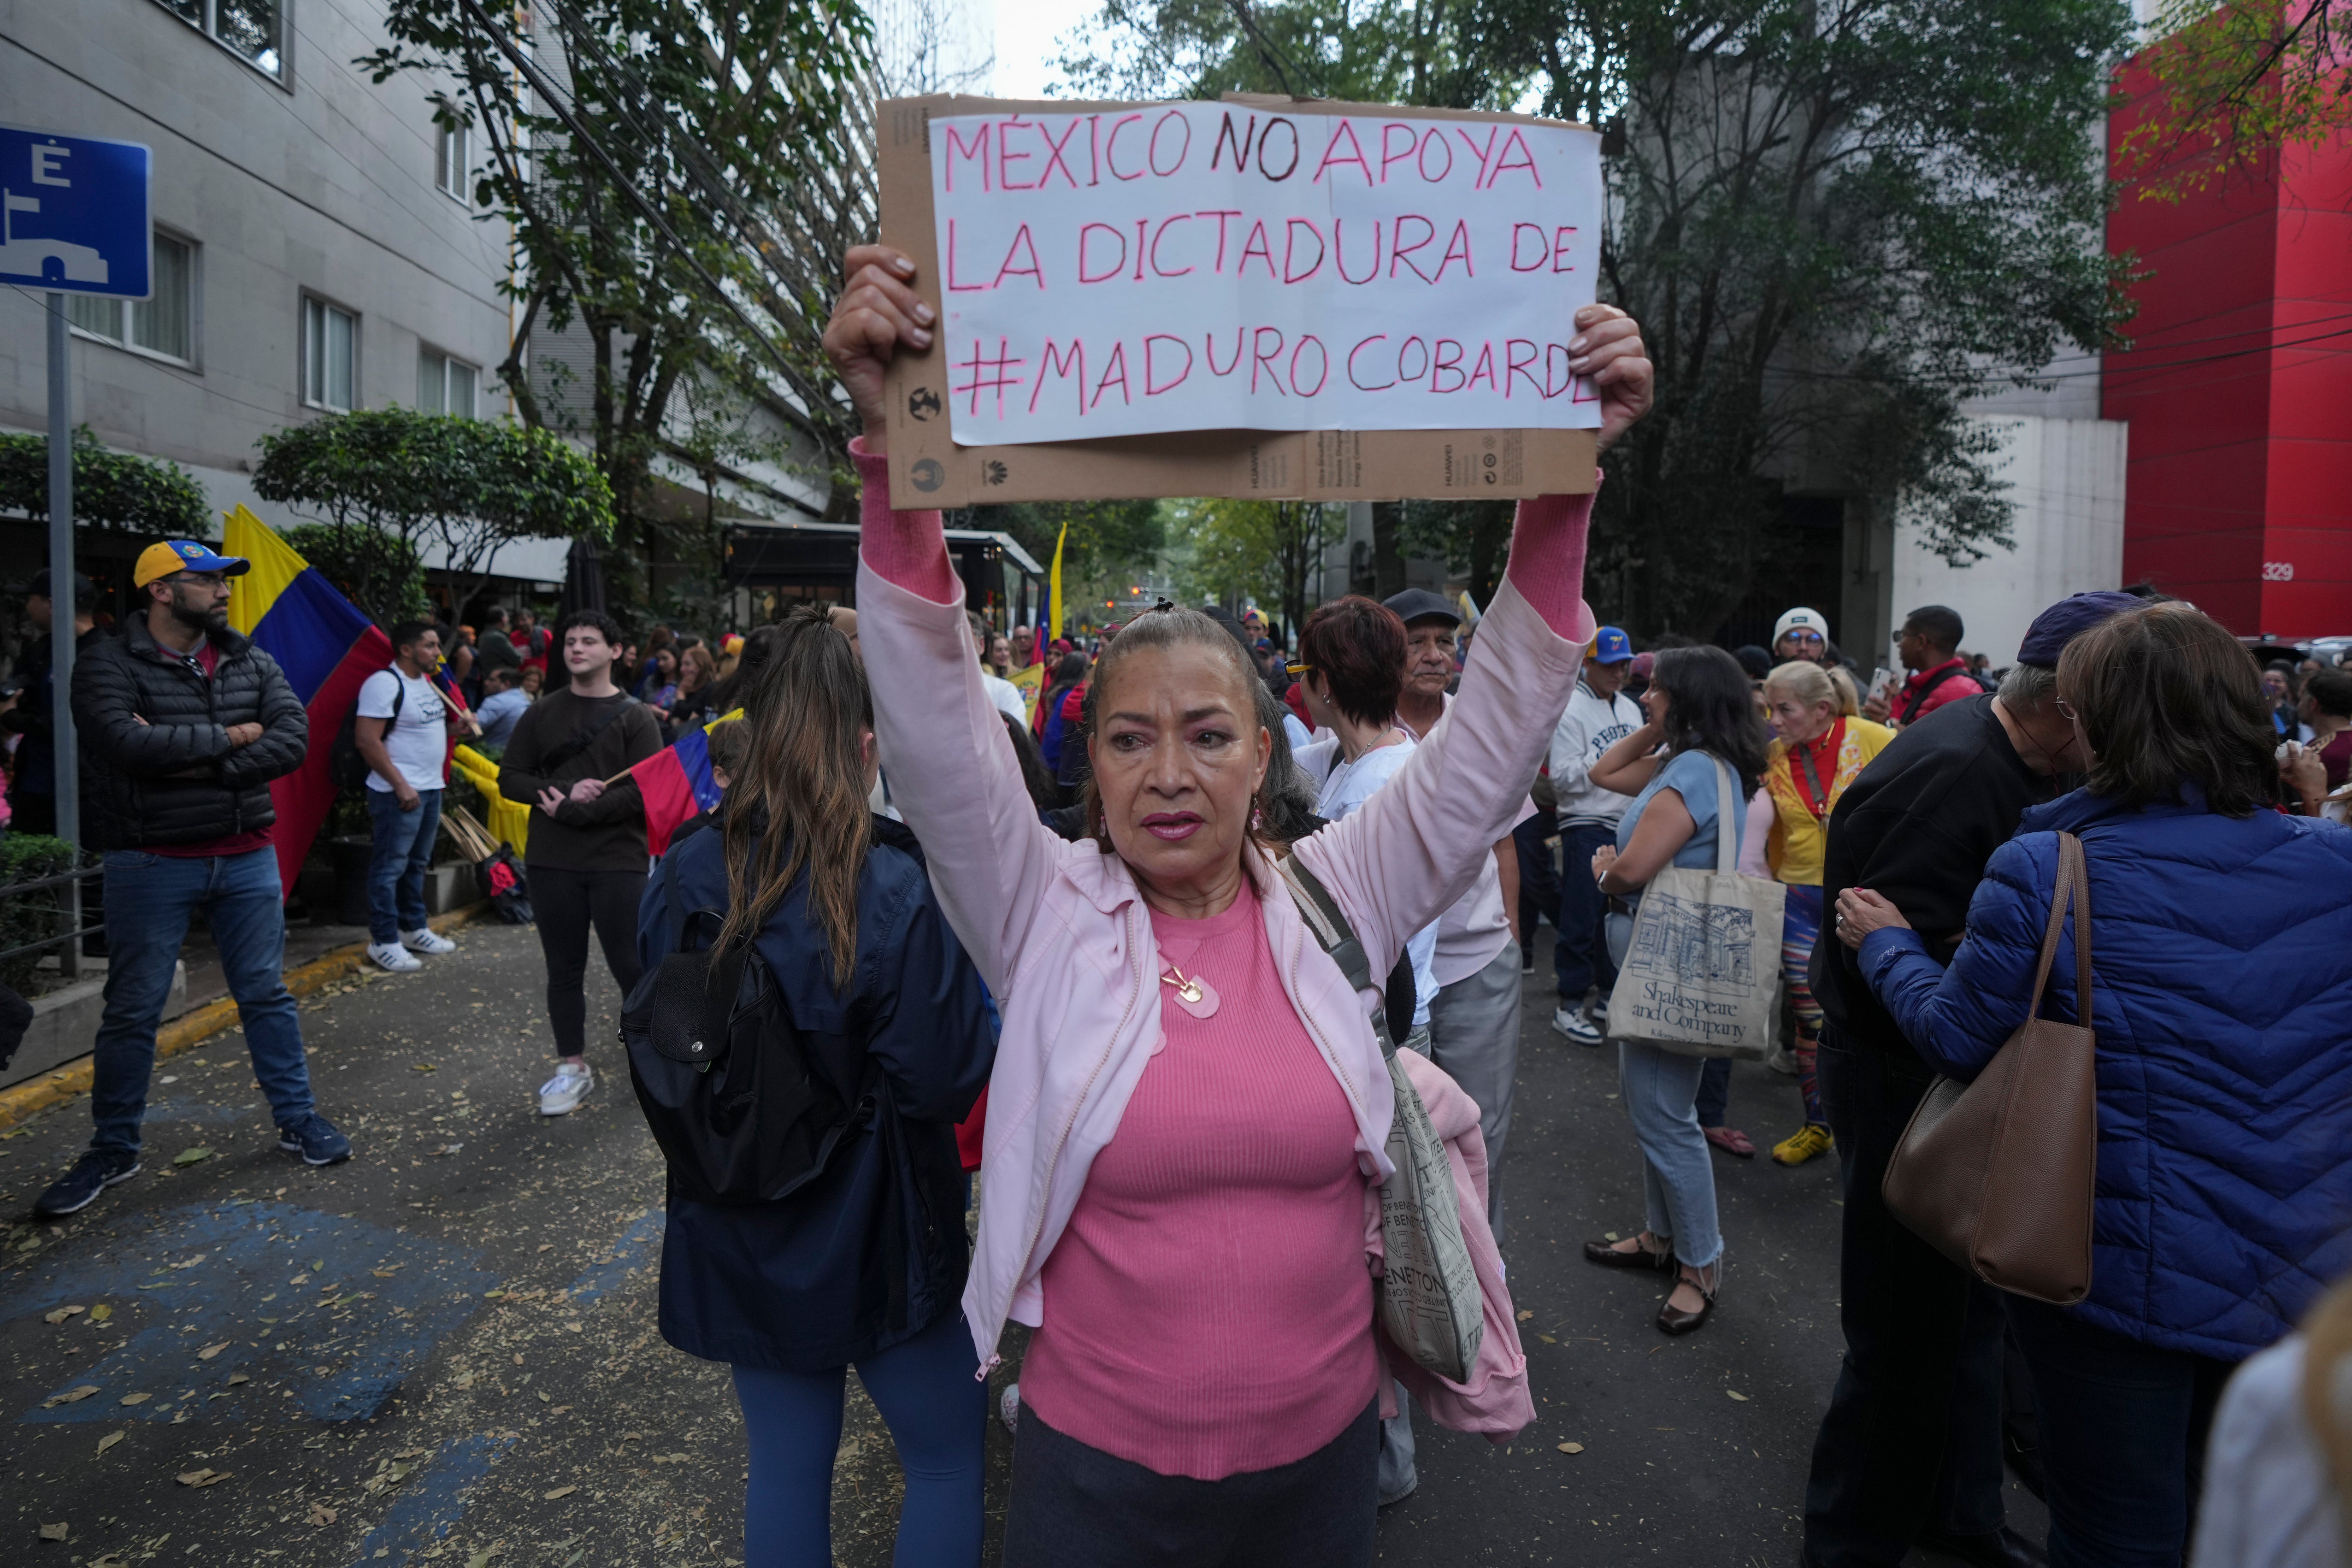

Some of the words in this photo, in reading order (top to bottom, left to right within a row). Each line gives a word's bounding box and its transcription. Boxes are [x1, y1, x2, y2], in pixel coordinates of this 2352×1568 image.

[31, 143, 71, 188] E
[946, 110, 1189, 193] MÉXICO
[1211, 112, 1298, 181] NO
[1313, 118, 1542, 190] APOYA
[947, 218, 1046, 293] LA
[1079, 210, 1474, 285] DICTADURA
[1510, 223, 1577, 273] DE
[951, 326, 1329, 420] #MADURO
[2262, 561, 2293, 581] 329
[1643, 982, 1738, 1017] Shakespeare
[1632, 1003, 1660, 1021] and
[1664, 1008, 1746, 1043] Company
[1383, 1203, 1392, 1212] OF
[1385, 1267, 1445, 1294] ENETTON
